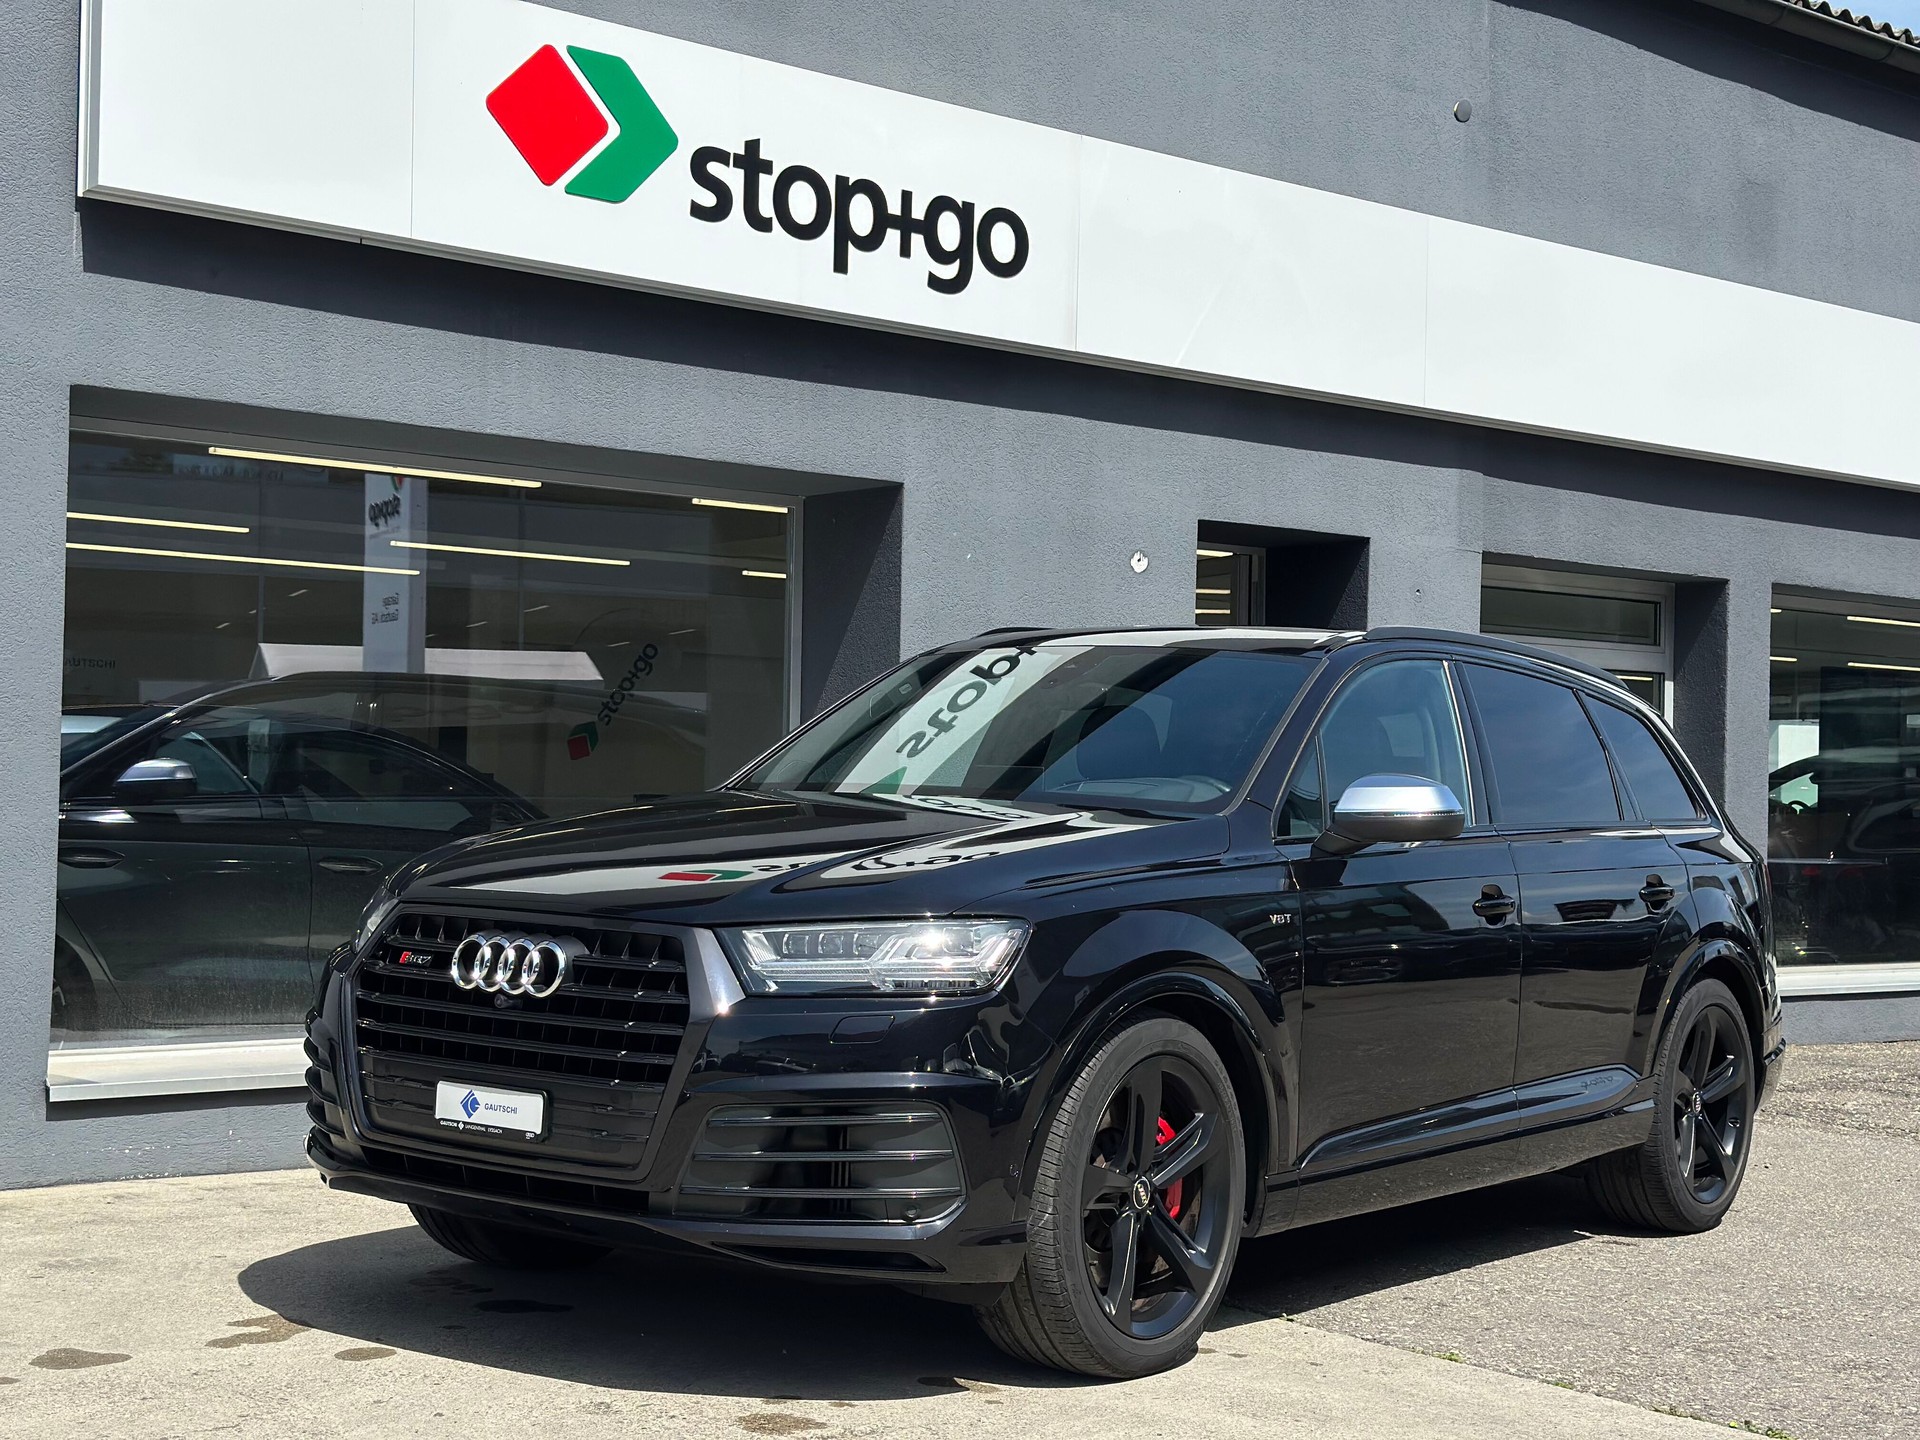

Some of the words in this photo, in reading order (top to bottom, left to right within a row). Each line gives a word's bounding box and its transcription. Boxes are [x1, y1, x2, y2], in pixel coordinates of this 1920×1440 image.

[689, 137, 1030, 295] stop+go
[597, 643, 659, 727] stop+go
[1580, 1075, 1614, 1090] quattro
[484, 1102, 518, 1115] GAUTSCHI
